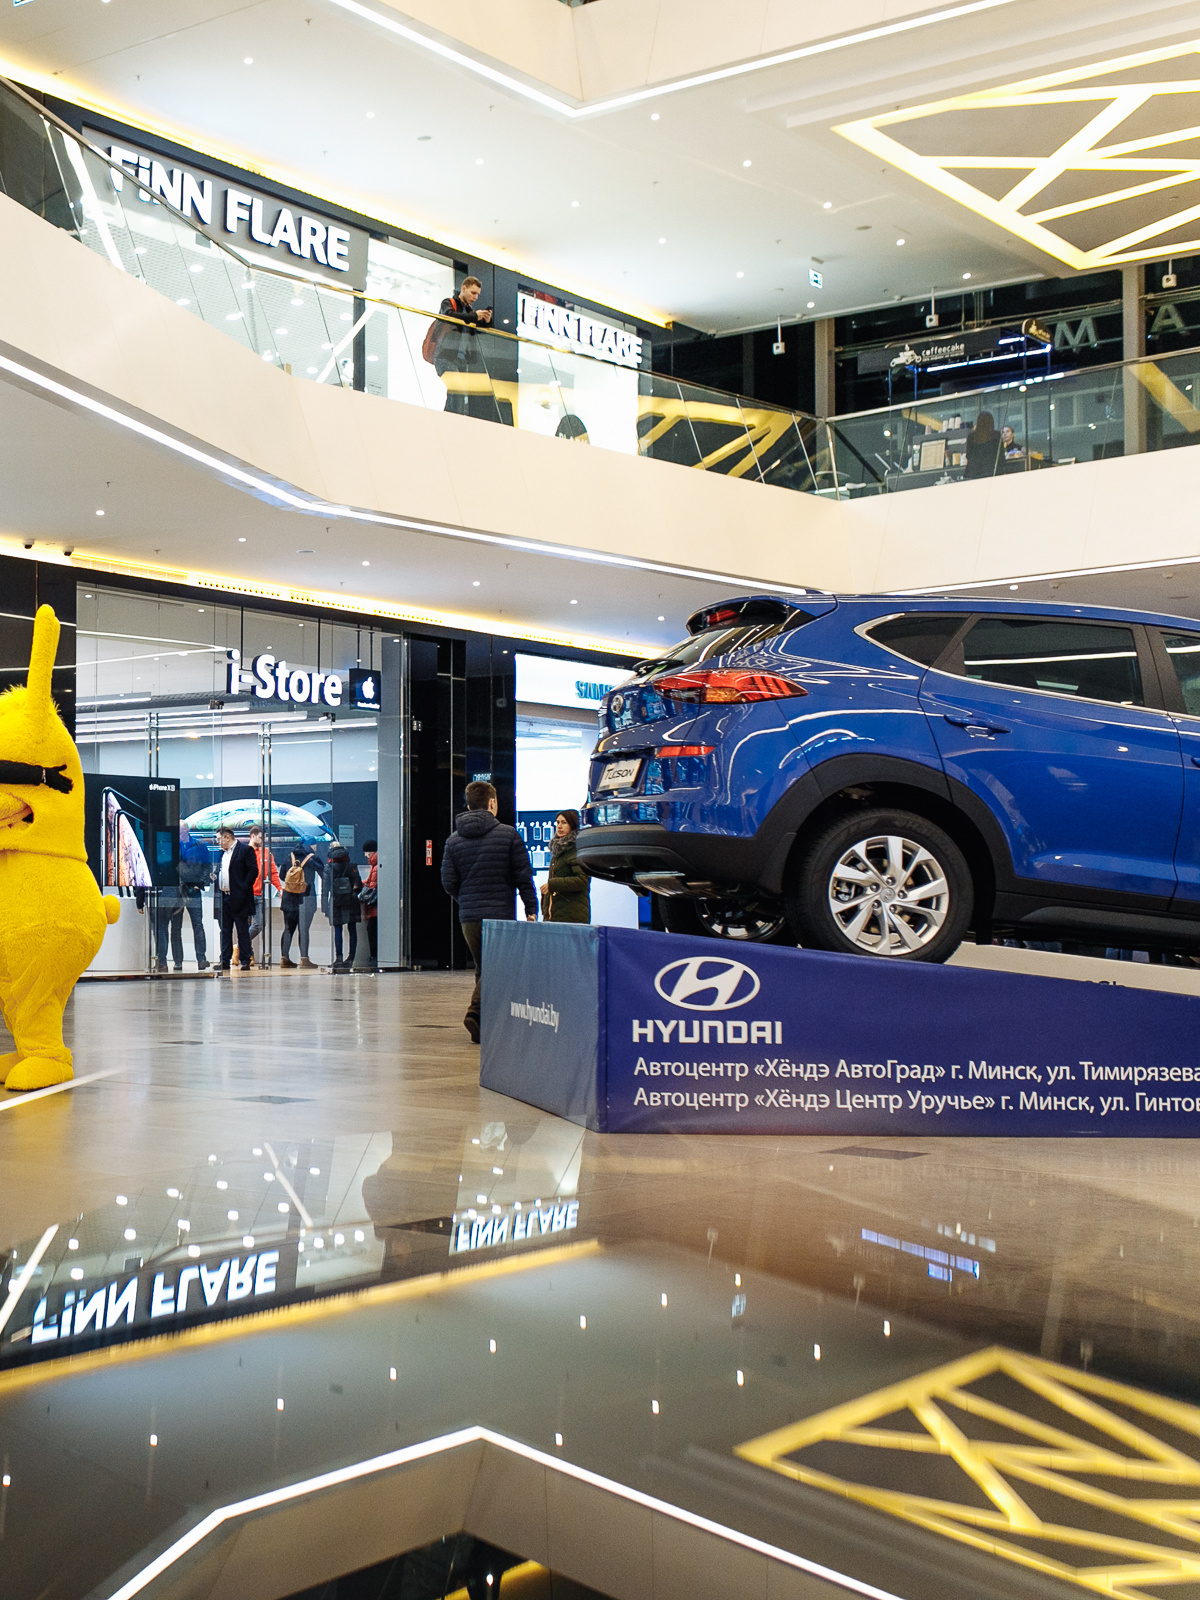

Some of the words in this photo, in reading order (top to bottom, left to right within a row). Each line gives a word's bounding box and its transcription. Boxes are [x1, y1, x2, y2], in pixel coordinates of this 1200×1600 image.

[225, 188, 350, 272] FLARE
[921, 343, 965, 357] coffeecake
[227, 648, 343, 707] i-Store
[510, 998, 560, 1033] www.hyundai.by
[632, 1019, 783, 1045] HYUNDAI
[633, 1056, 749, 1082] Автоцентр
[754, 1058, 830, 1082] «Хёндэ
[835, 1058, 946, 1084] АвтоГрад»
[951, 1064, 964, 1080] г.
[968, 1060, 1042, 1083] Минск,
[1047, 1065, 1076, 1086] ул.
[633, 1087, 749, 1112] Автоцентр
[754, 1088, 830, 1112] «Хёндэ
[836, 1089, 903, 1114] Центр
[906, 1089, 996, 1115] Уручье»
[1001, 1095, 1014, 1111] г.
[1019, 1091, 1095, 1114] Минск,
[1099, 1095, 1130, 1116] ул.
